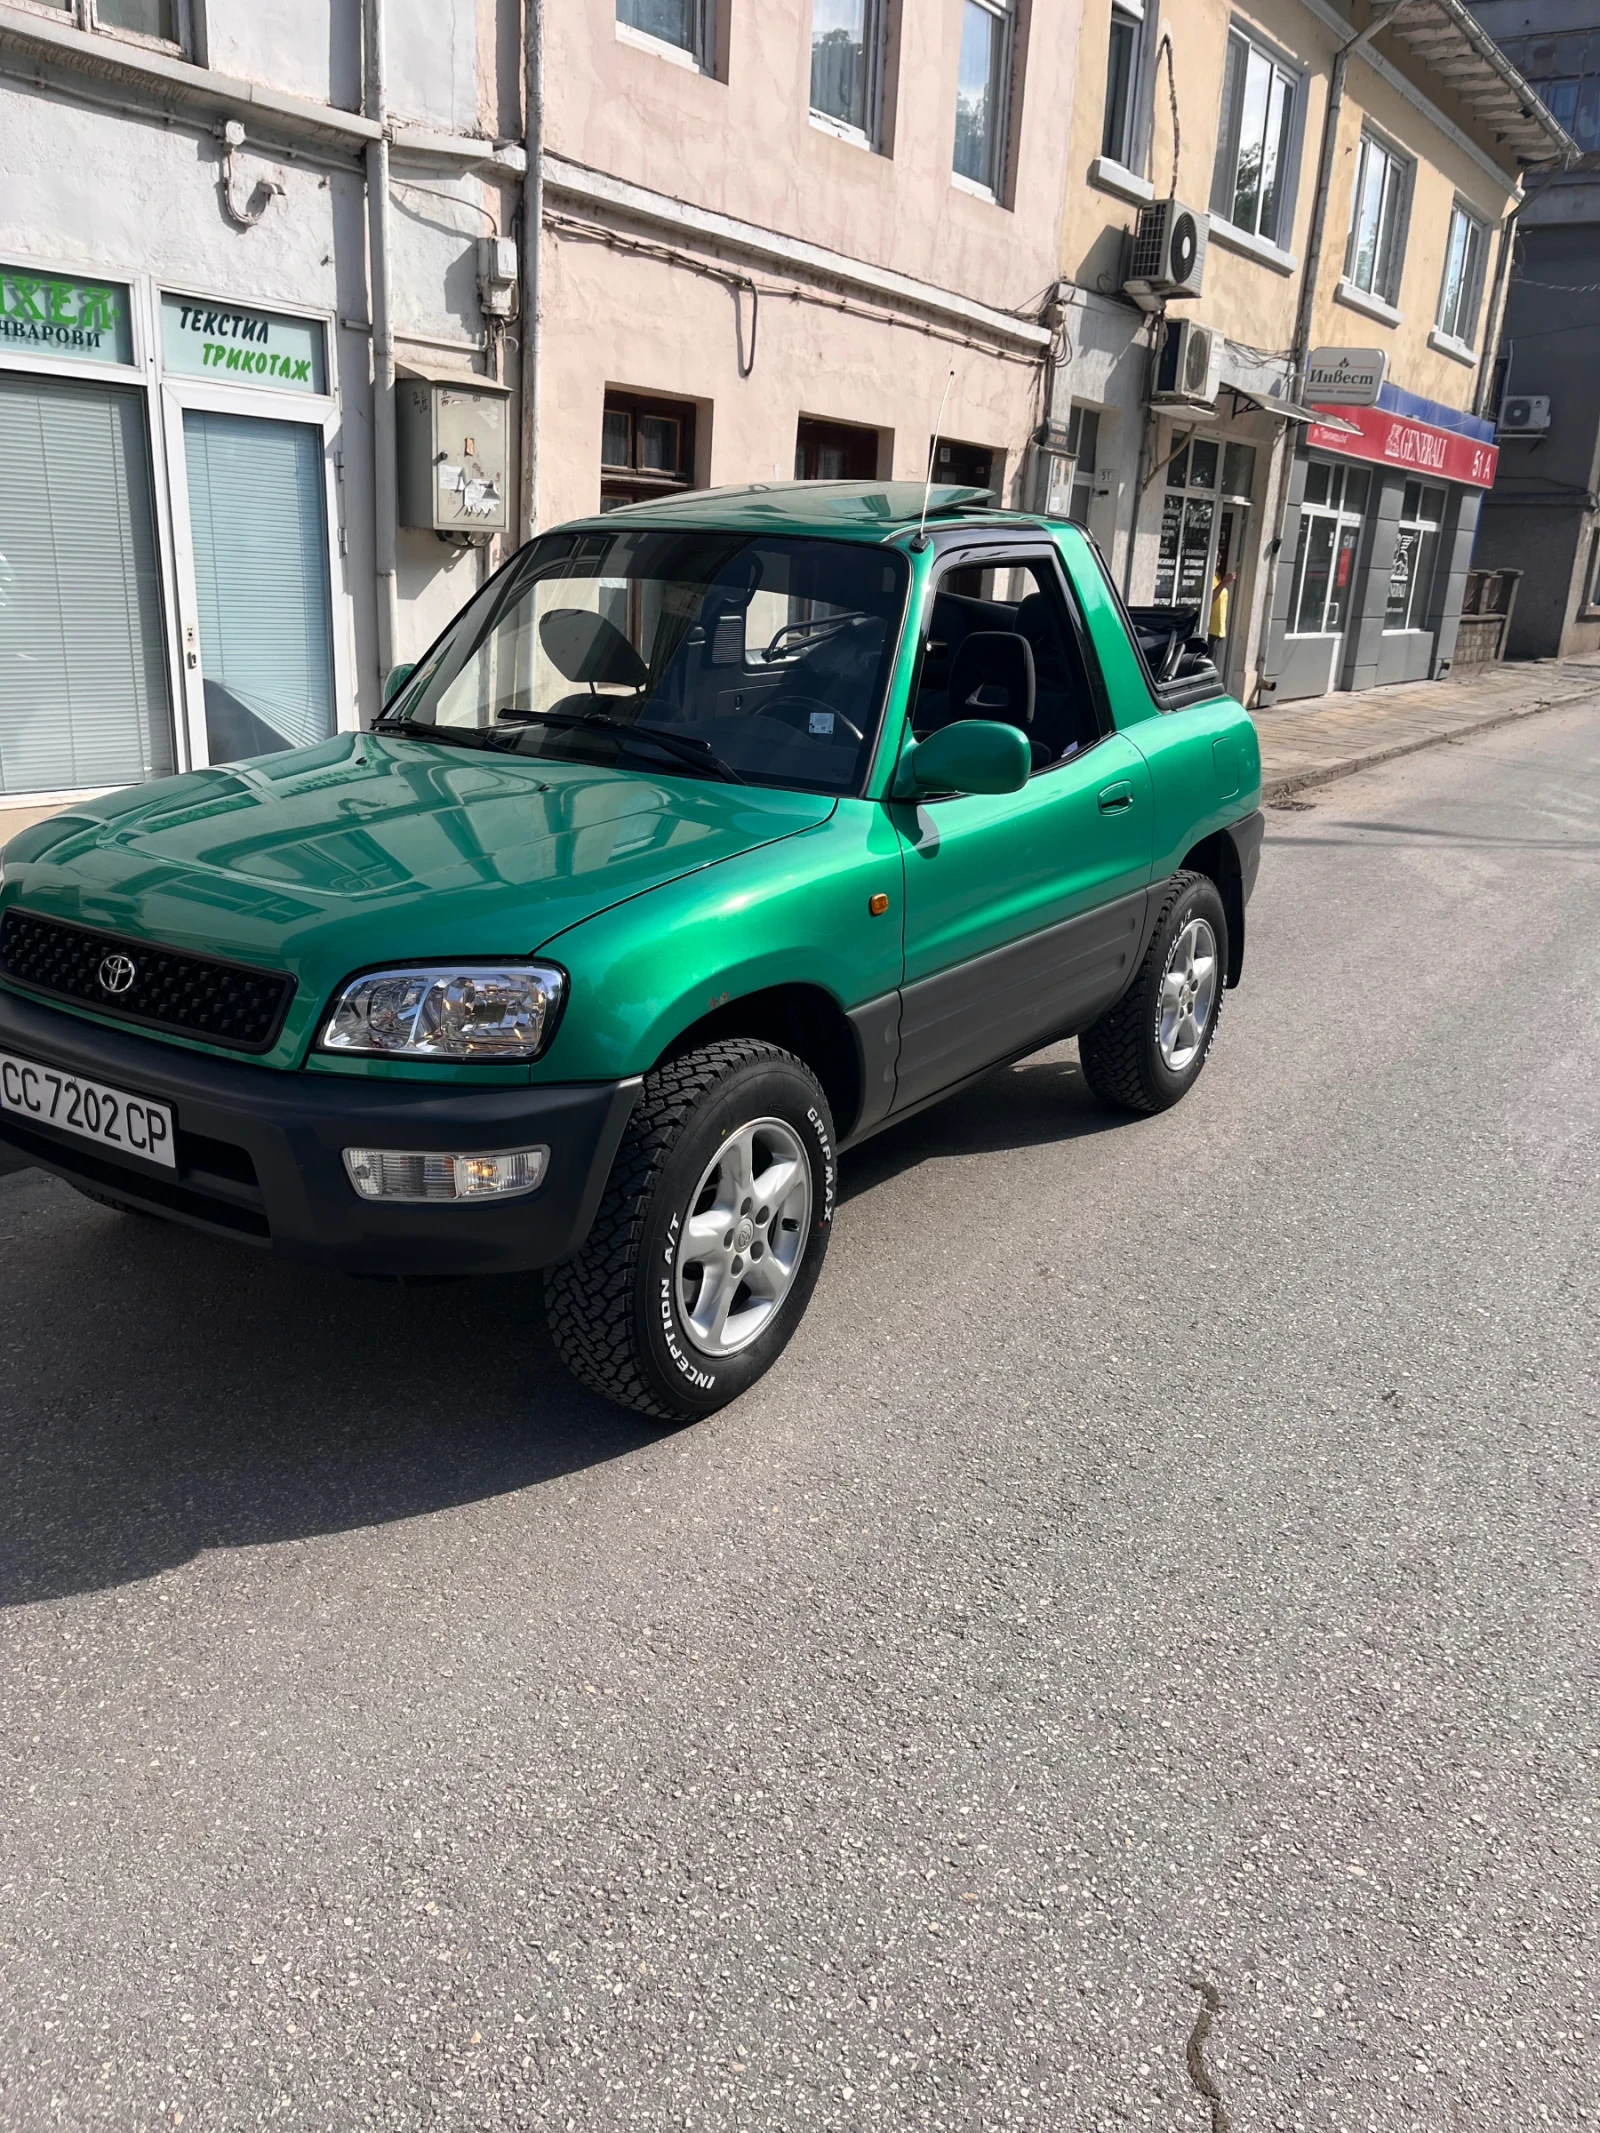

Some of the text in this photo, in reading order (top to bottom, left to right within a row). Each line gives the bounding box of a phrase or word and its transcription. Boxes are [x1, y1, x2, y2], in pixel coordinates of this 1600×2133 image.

[0, 274, 113, 330] ХЕЛ
[180, 306, 269, 344] ТЕКСТИЛ
[202, 343, 311, 382] ТРИКОТАЖ
[1309, 369, 1374, 385] Инвест
[1400, 428, 1448, 469] GENERALI
[1472, 450, 1485, 477] 51
[661, 1212, 716, 1390] INCEPTION A/T
